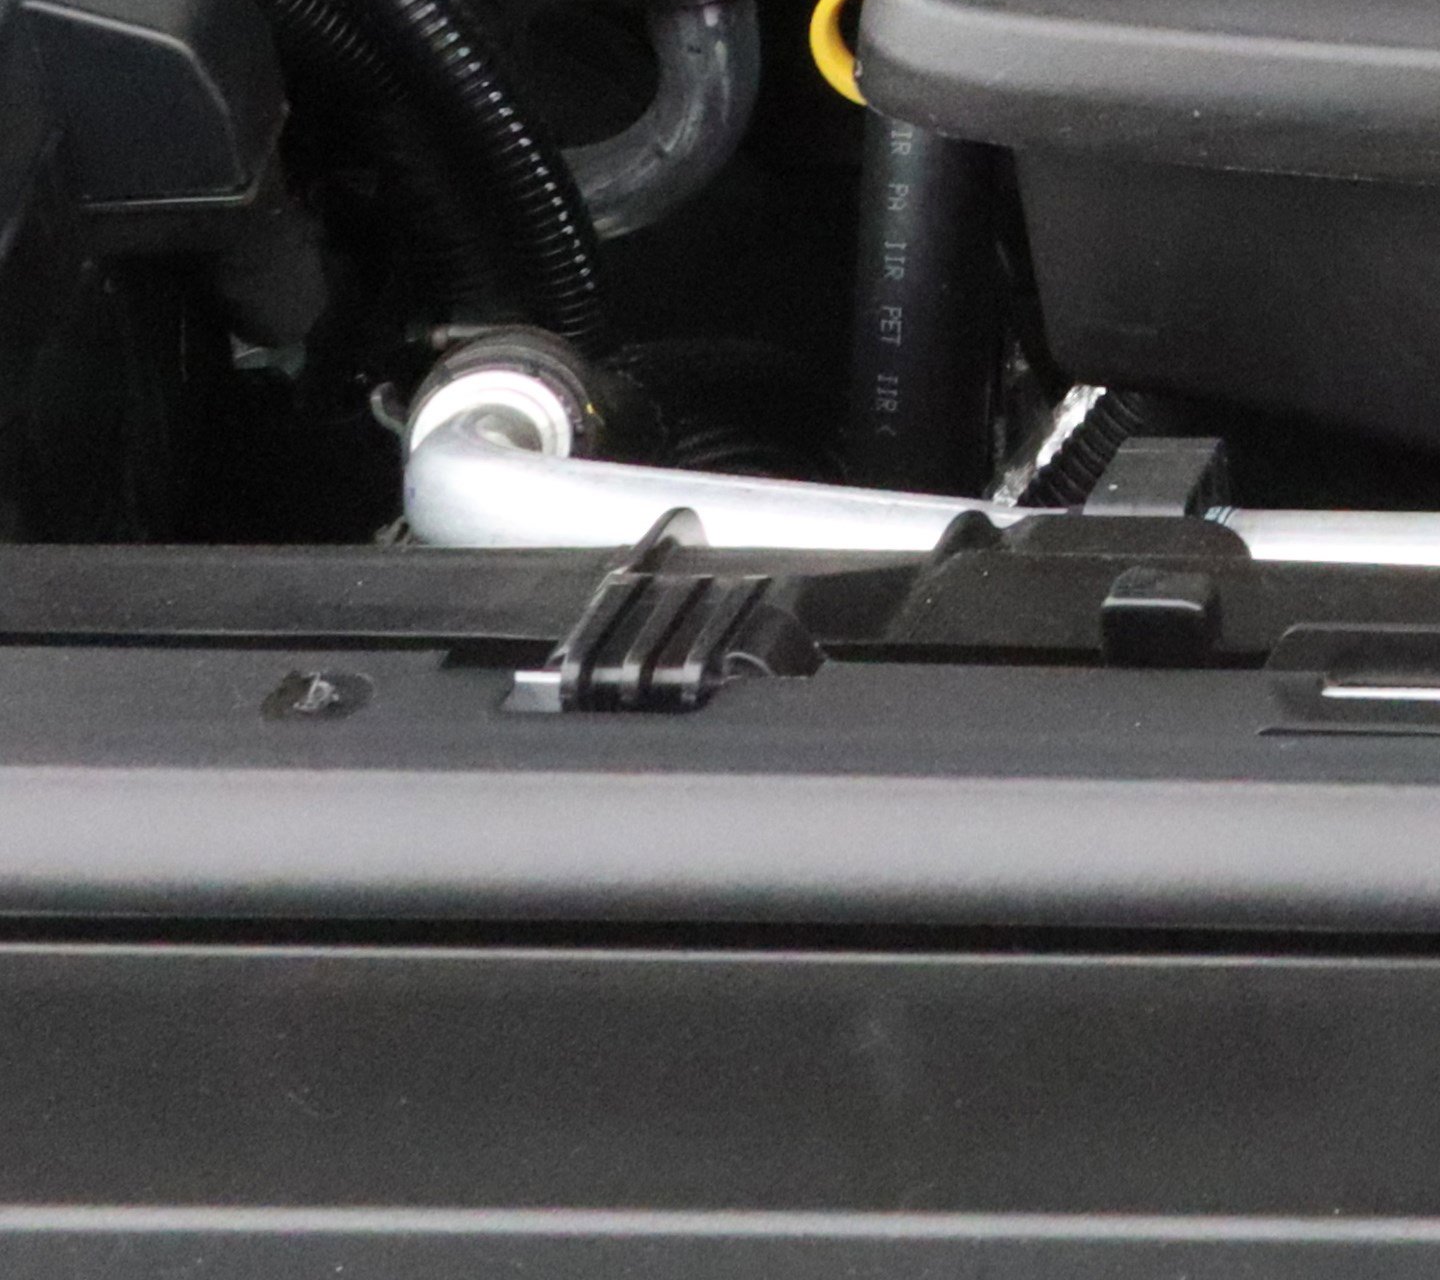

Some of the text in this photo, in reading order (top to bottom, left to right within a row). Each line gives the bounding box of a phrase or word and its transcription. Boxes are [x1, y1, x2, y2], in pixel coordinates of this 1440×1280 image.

[887, 183, 909, 211] PA
[883, 240, 908, 280] IIR
[880, 305, 903, 347] PET
